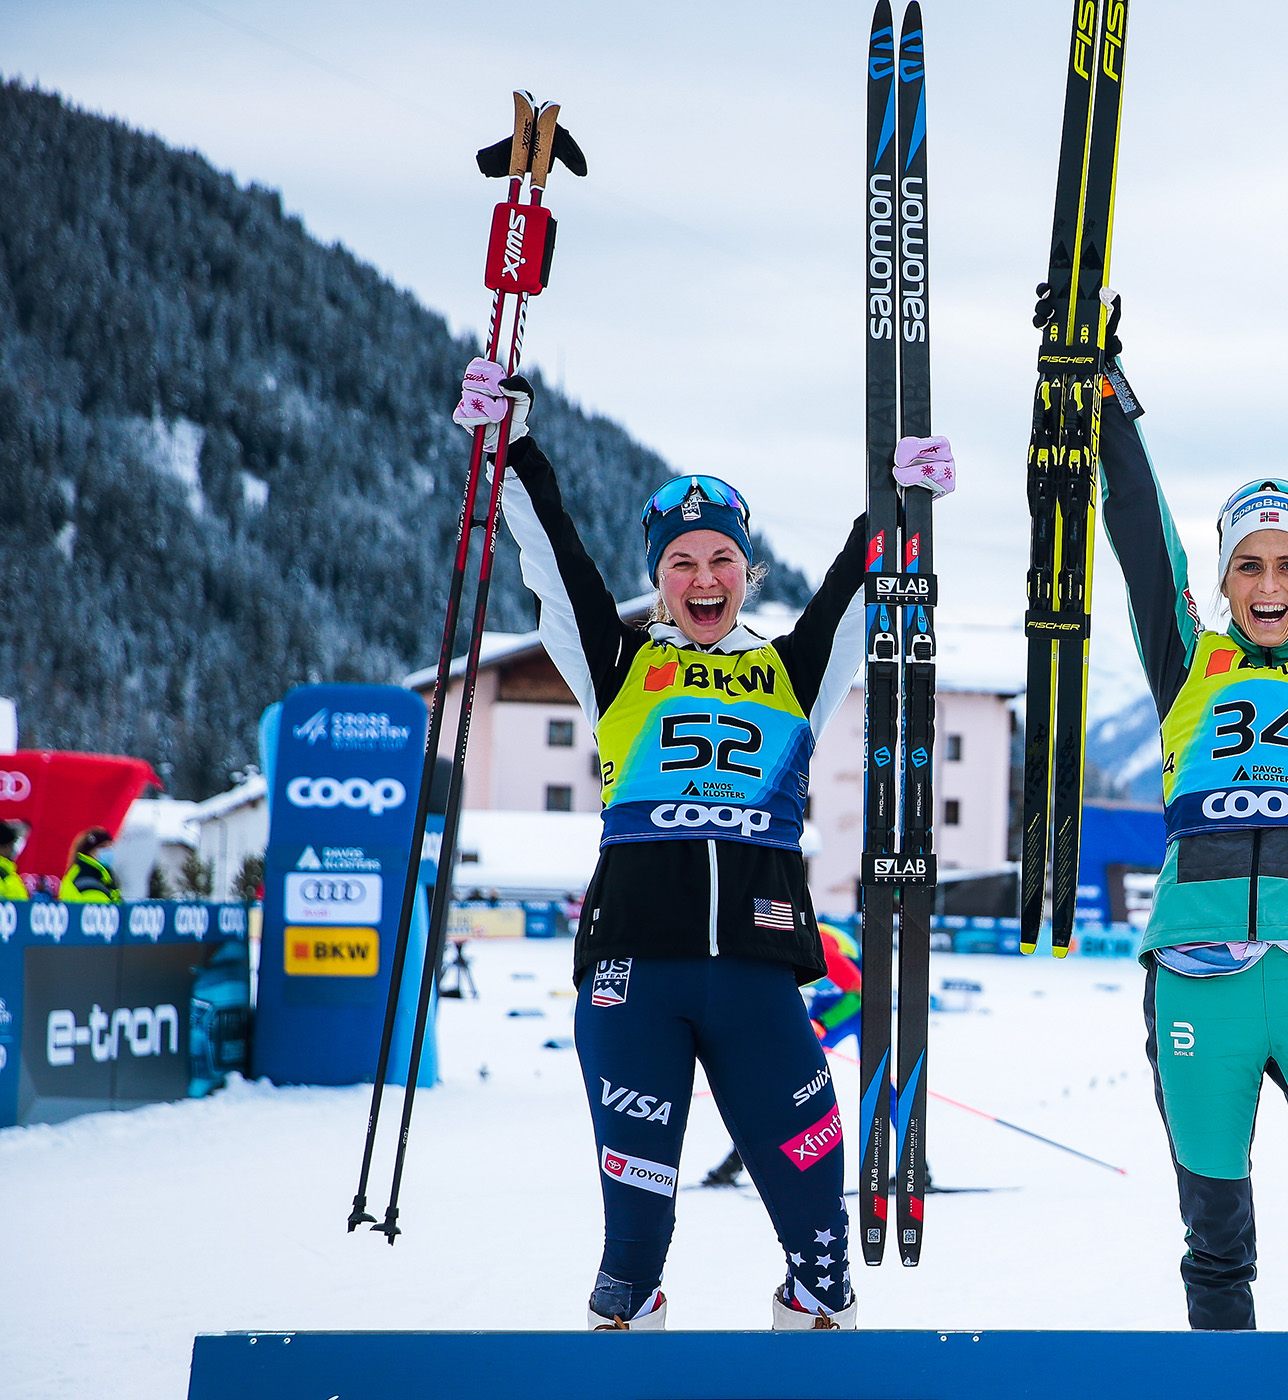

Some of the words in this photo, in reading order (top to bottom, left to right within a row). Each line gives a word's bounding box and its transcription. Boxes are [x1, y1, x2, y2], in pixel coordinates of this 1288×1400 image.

[869, 174, 893, 341] salomon
[901, 176, 926, 344] salomon
[1050, 325, 1059, 342] 3D
[1080, 327, 1090, 344] 3D
[1039, 355, 1095, 364] FISCHER
[1026, 620, 1081, 631] FISCHER
[683, 662, 776, 698] BKW
[660, 712, 764, 780] 52
[287, 776, 407, 817] coop
[702, 789, 746, 800] KLOSTERS
[650, 803, 772, 837] coop
[313, 941, 371, 961] BKW
[47, 1003, 179, 1067] e-tron
[600, 1076, 672, 1125] VISA
[792, 1114, 841, 1161] xfinit
[629, 1166, 673, 1188] TOYOTA
